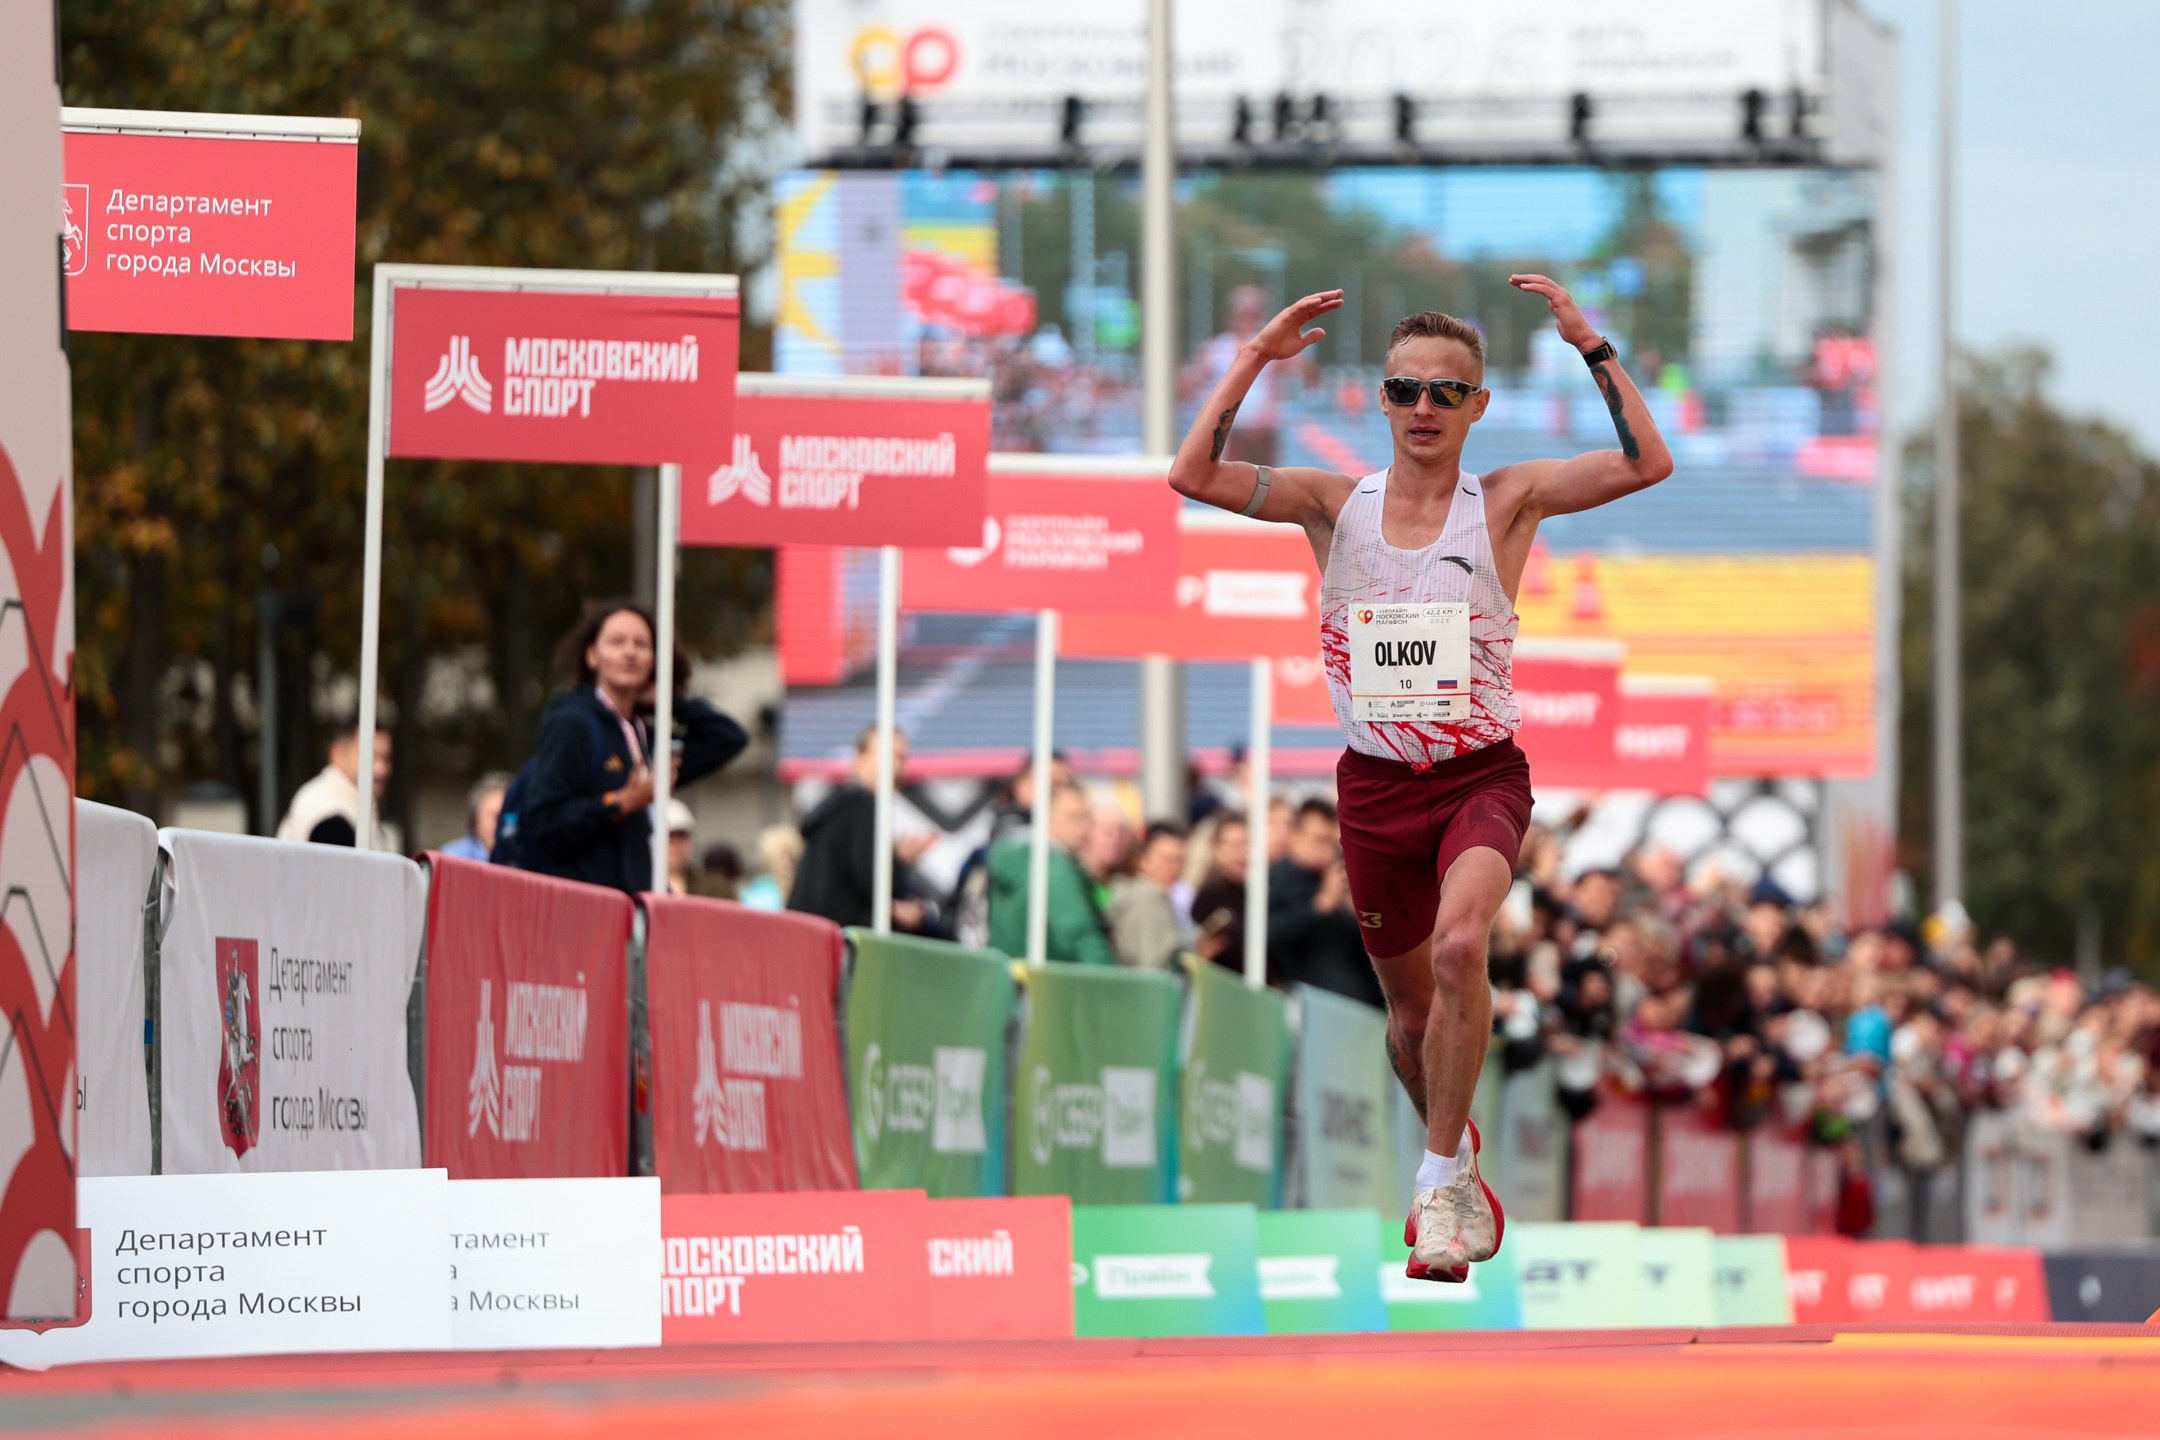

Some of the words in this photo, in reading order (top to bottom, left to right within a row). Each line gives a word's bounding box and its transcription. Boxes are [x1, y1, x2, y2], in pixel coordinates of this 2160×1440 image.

[106, 189, 272, 217] Департамент
[106, 223, 192, 248] спорта
[106, 254, 192, 278] города
[200, 253, 297, 278] Москвы
[504, 335, 699, 382] МОСКОВСКИЙ
[503, 378, 596, 418] СПОРТ
[779, 432, 956, 477] МОСКОВСКИЙ
[779, 471, 863, 509] СПОРТ
[1375, 640, 1436, 666] OLKOV
[1399, 679, 1412, 689] 10
[269, 946, 353, 1006] Департамент
[272, 1026, 313, 1074] спорта
[115, 1224, 328, 1256] Департамент
[661, 1226, 864, 1275] ОСКОВСКИЙ
[928, 1230, 1014, 1276] СКИЙ
[117, 1260, 226, 1290] спорта
[117, 1295, 228, 1323] города
[238, 1291, 362, 1316] Москвы
[469, 1290, 580, 1311] Москвы
[661, 1276, 745, 1316] ПОРТ
